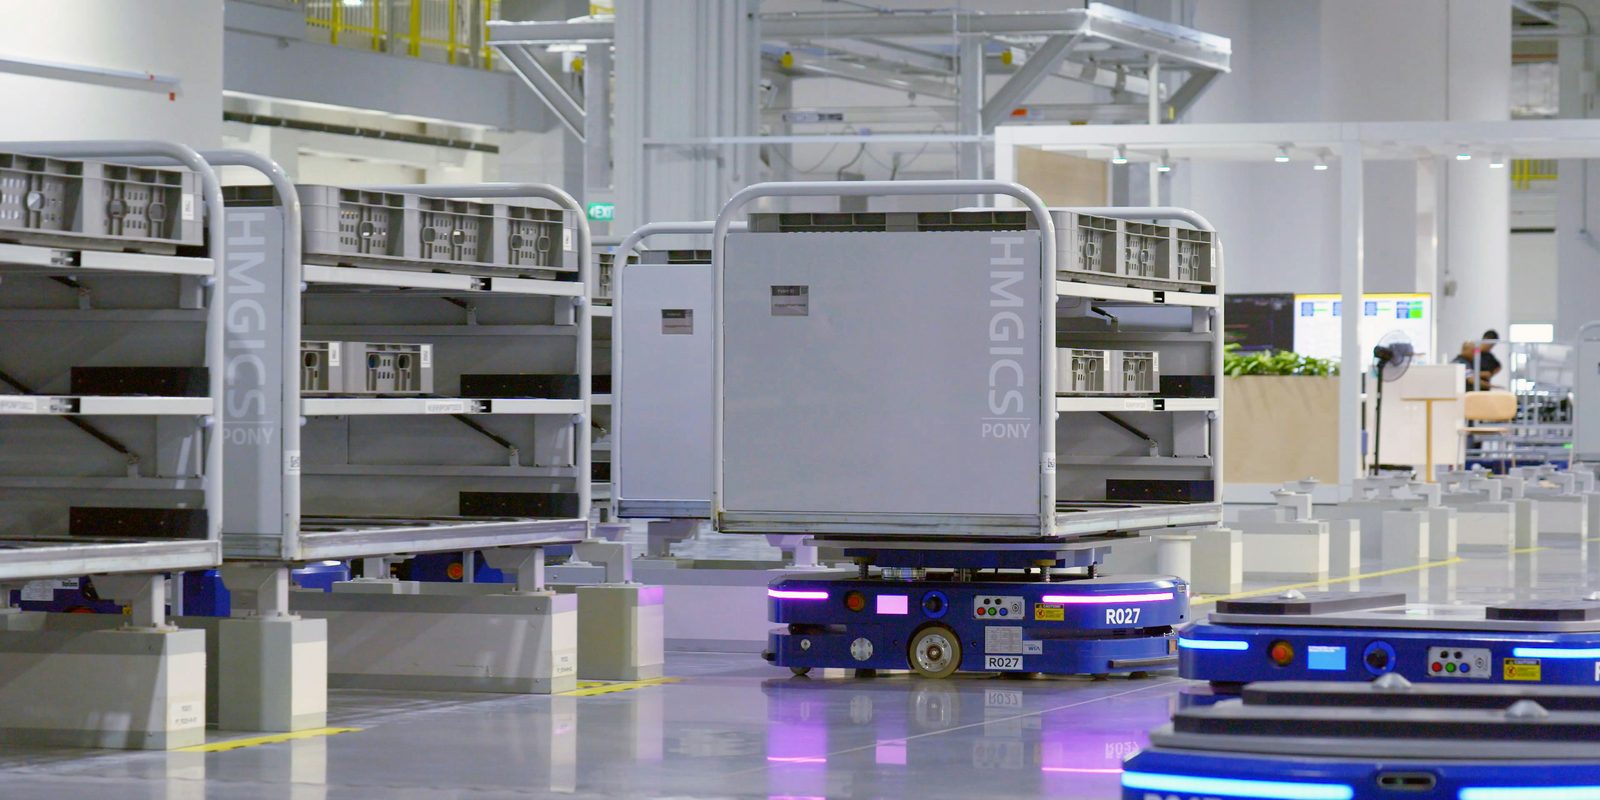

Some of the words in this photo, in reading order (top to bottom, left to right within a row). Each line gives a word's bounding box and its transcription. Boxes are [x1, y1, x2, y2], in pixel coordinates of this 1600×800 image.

[227, 212, 266, 419] HMGICS
[988, 237, 1024, 415] HMGICS
[982, 423, 1031, 439] PONY
[1105, 608, 1141, 625] R027
[988, 657, 1020, 668] R027
